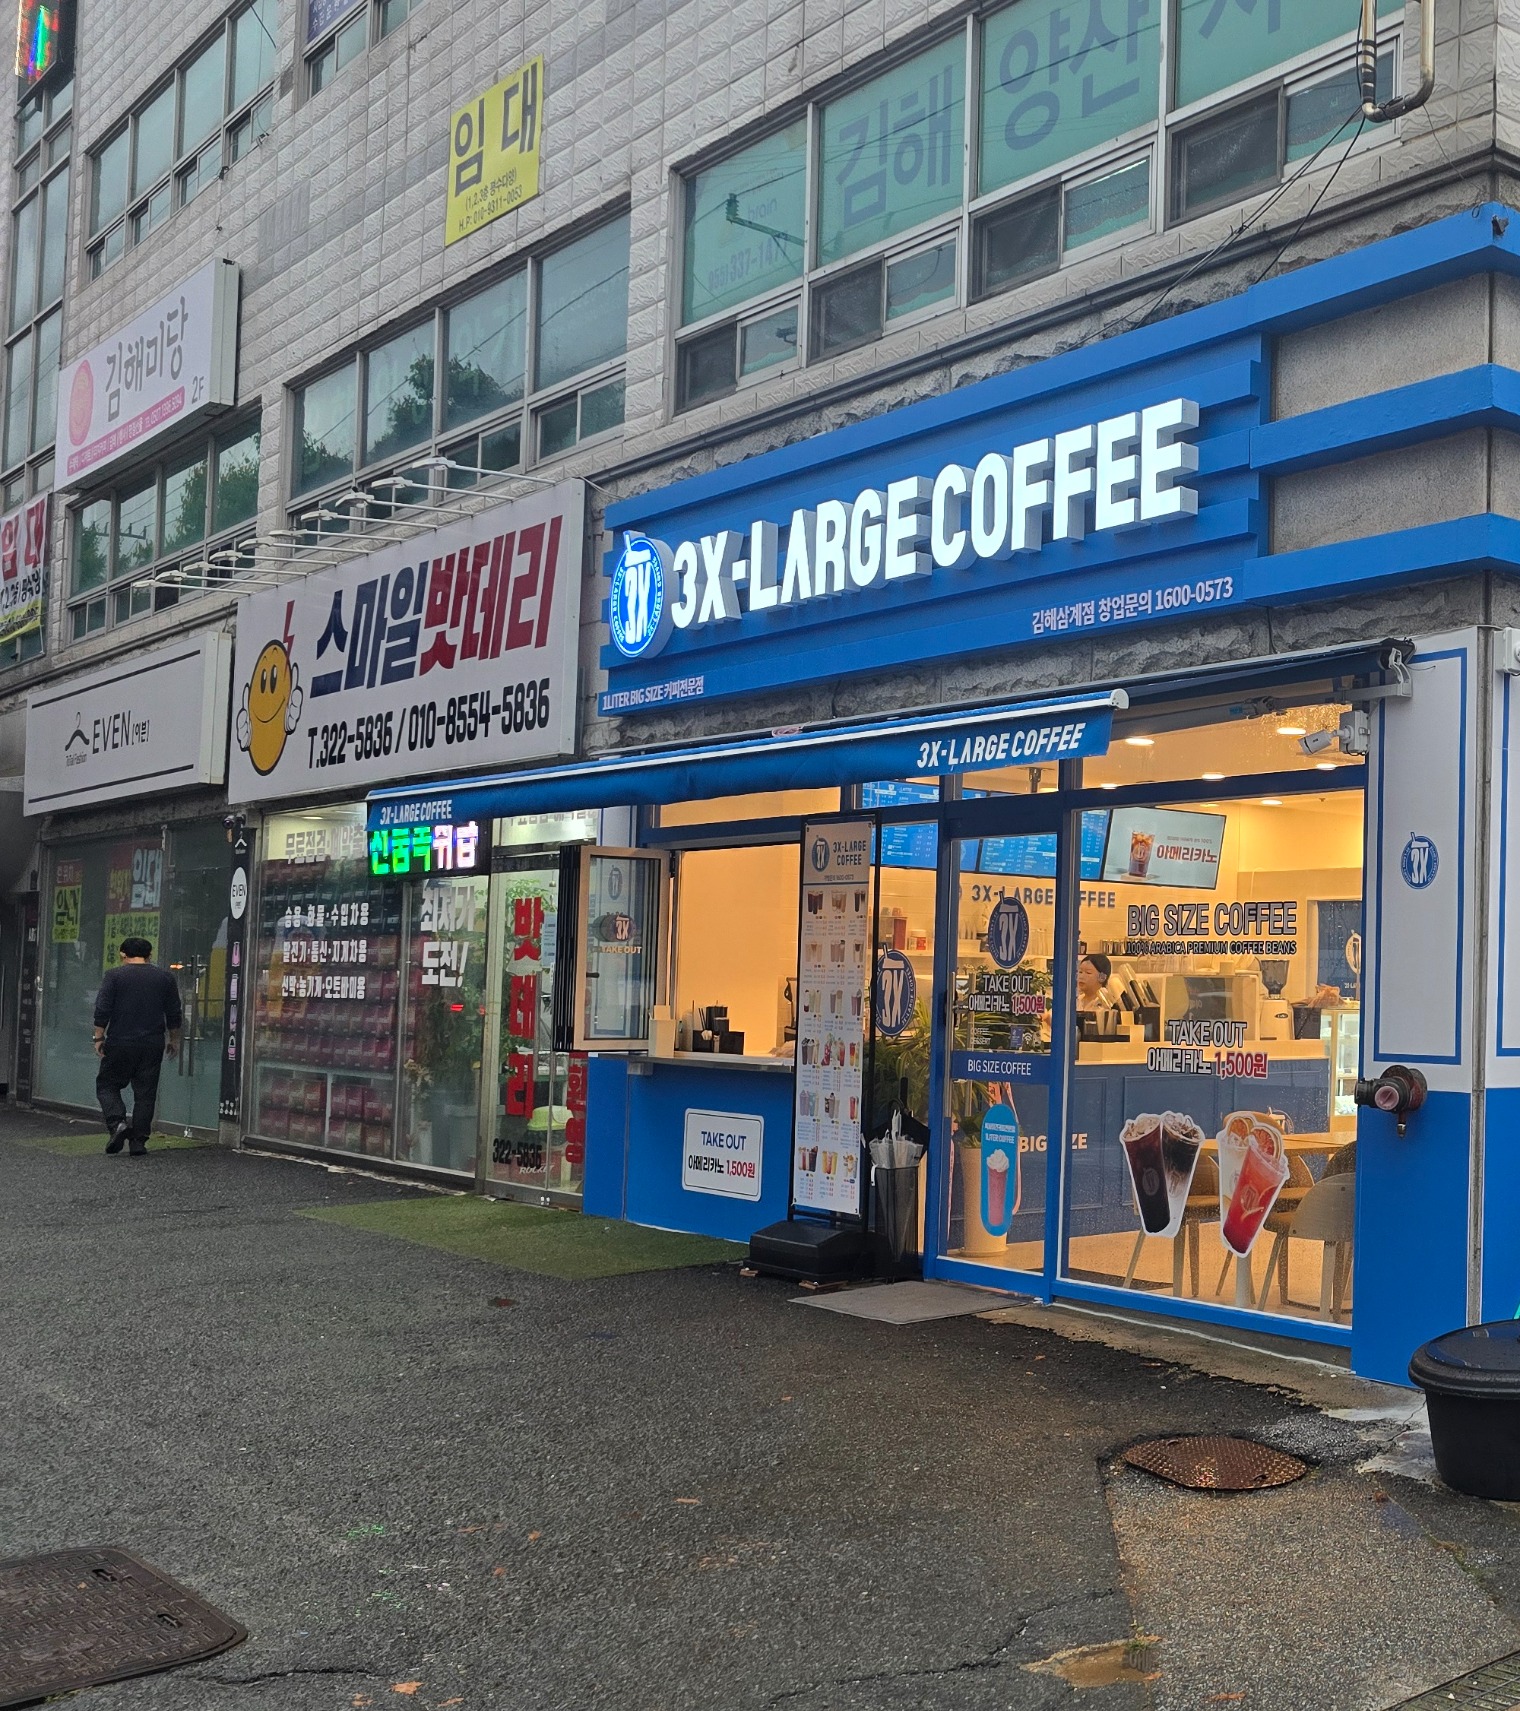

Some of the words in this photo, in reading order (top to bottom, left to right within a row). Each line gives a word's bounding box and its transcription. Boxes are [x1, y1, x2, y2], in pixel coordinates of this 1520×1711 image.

[454, 62, 538, 198] 임대
[837, 61, 953, 230] 김해
[1002, 0, 1142, 152] 양산
[106, 296, 189, 422] 김해미당
[192, 376, 204, 404] 2F
[671, 476, 930, 629] 3X-LARGE
[931, 398, 1199, 568] COFFEE
[625, 562, 651, 645] 3X
[1032, 601, 1095, 634] 김해삼계점
[1098, 589, 1152, 622] 창업문의
[1155, 577, 1233, 610] 1600-0573
[602, 692, 630, 711] 1LITER
[631, 688, 645, 706] BIG
[645, 685, 664, 703] SIZE
[662, 675, 704, 700] 커피전문점
[92, 710, 131, 754] EVEN
[308, 710, 393, 770] T.322-5836
[408, 678, 551, 751] 010-8554-5836
[917, 731, 1009, 769] 3X-LARGE
[1012, 722, 1087, 759] COFFEE
[380, 803, 421, 825] 3X-LARGE
[420, 799, 452, 821] COFFEE
[833, 841, 866, 853] 3X-LARGE
[837, 854, 862, 866] COFFEE
[1156, 844, 1217, 863] 아메리카노
[284, 906, 301, 928] 승용
[421, 885, 475, 932] 최저가
[1127, 904, 1160, 936] BIG
[1164, 903, 1209, 936] SIZE
[1213, 901, 1298, 936] COFFEE
[602, 946, 623, 954] TAKE
[624, 946, 642, 955] OUT
[1150, 941, 1186, 954] ARABICA
[1187, 941, 1228, 954] PREMIUM
[1230, 941, 1264, 954] COFFEE
[1265, 940, 1297, 954] BEANS
[421, 941, 469, 987] 도전!
[983, 974, 1009, 993] TAKE
[1011, 975, 1032, 993] OUT
[506, 897, 544, 1119] 밧데리
[969, 994, 1010, 1012] 아메리카노
[1168, 1020, 1210, 1046] TAKE
[1212, 1021, 1247, 1048] OUT
[968, 1059, 981, 1072] BIG
[982, 1060, 1000, 1074] SIZE
[1001, 1061, 1031, 1075] COFFEE
[1147, 1047, 1212, 1075] 아메리카노
[1213, 1051, 1268, 1080] 1,500원
[492, 1138, 542, 1168] 322-5836
[701, 1130, 724, 1148] TAKE
[725, 1133, 746, 1152] OUT
[1018, 1135, 1047, 1152] BIG
[688, 1155, 724, 1174] 아메리카노
[726, 1158, 756, 1179] 1,500원
